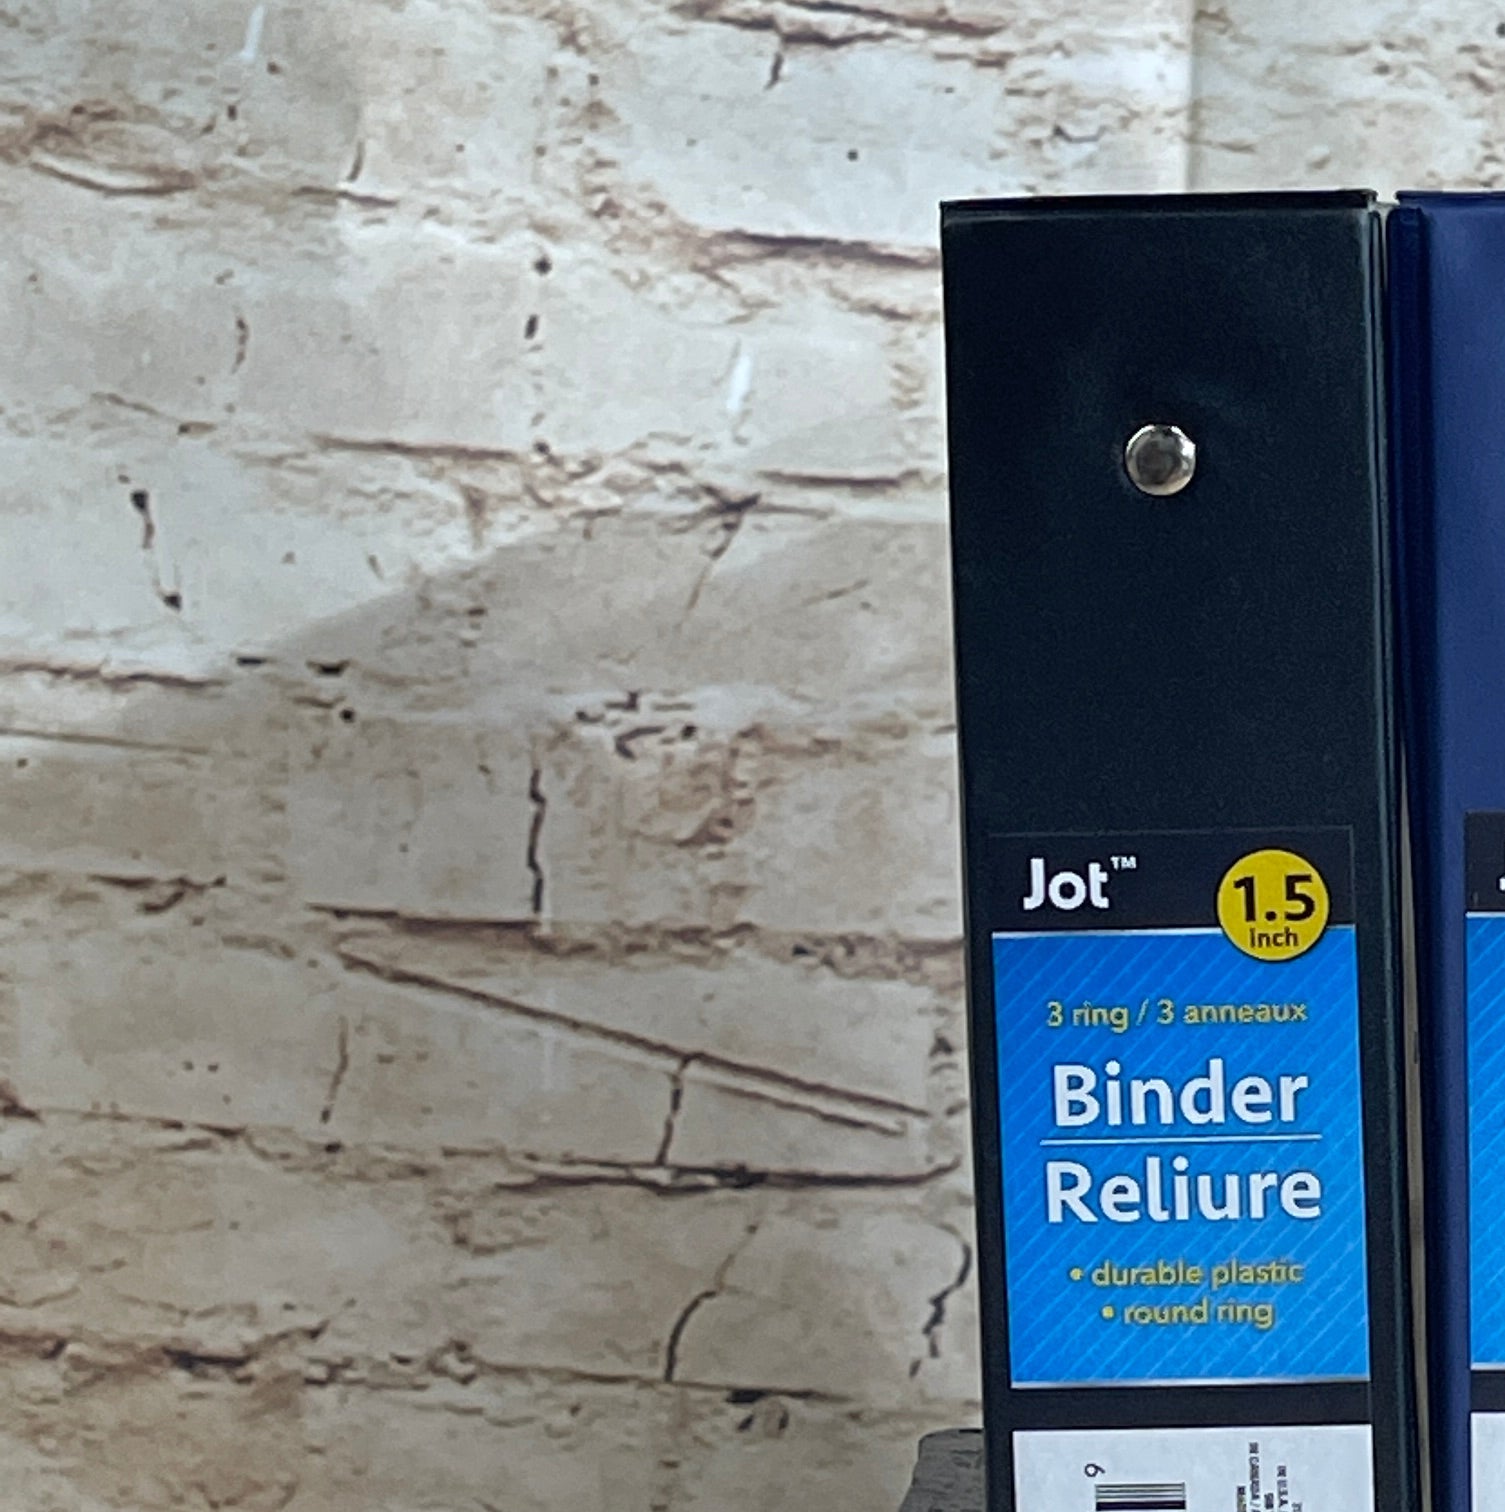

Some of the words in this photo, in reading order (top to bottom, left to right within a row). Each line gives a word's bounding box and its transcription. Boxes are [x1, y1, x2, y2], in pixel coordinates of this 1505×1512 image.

[1233, 873, 1316, 924] 1.5
[1046, 1001, 1063, 1027] 3
[1073, 998, 1129, 1034] ring
[1157, 998, 1174, 1025] 3
[1184, 1001, 1308, 1024] anneaux
[1052, 1057, 1308, 1128] Binder
[1045, 1154, 1322, 1224] Reliure
[1092, 1261, 1204, 1286] durable
[1211, 1258, 1304, 1290] plastic
[1123, 1299, 1209, 1325] round
[1217, 1296, 1274, 1330] ring
[1084, 1463, 1106, 1478] 6
